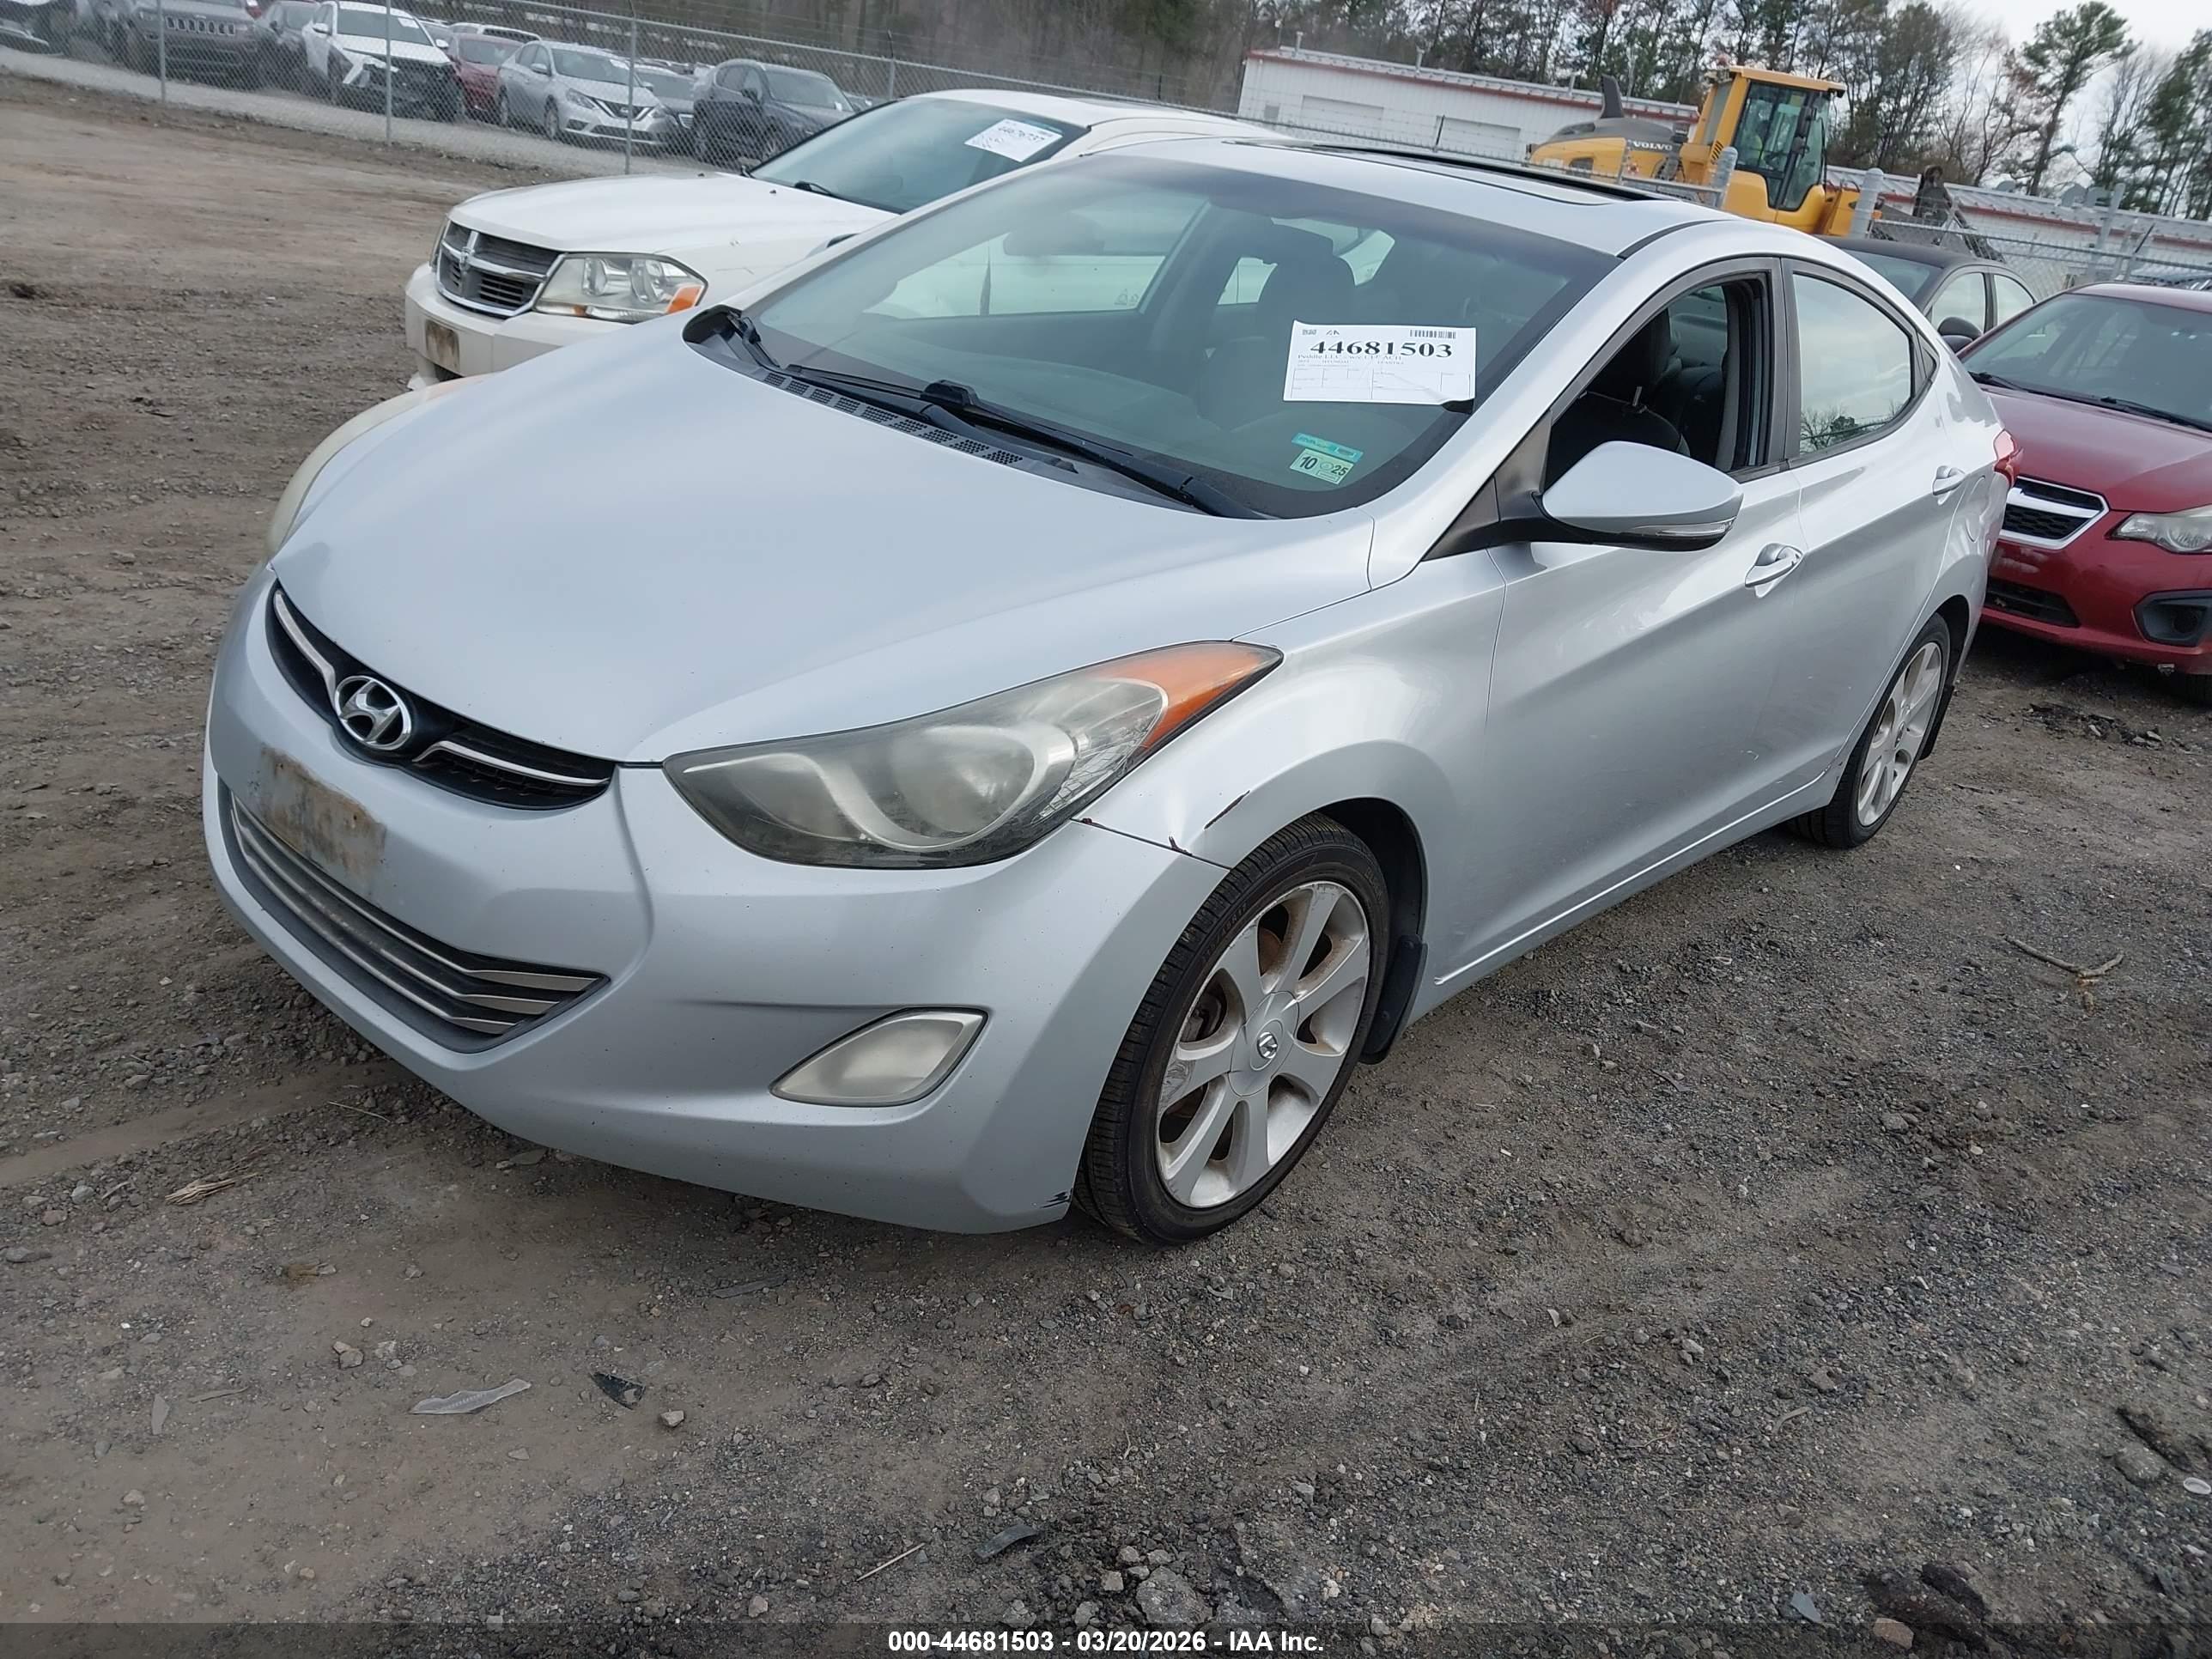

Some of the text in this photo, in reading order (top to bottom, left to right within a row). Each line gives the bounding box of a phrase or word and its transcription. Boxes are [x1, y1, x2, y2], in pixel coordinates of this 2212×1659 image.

[1632, 140, 1673, 151] VOLVO
[1310, 341, 1453, 358] 44681503
[1299, 456, 1348, 476] 10 25
